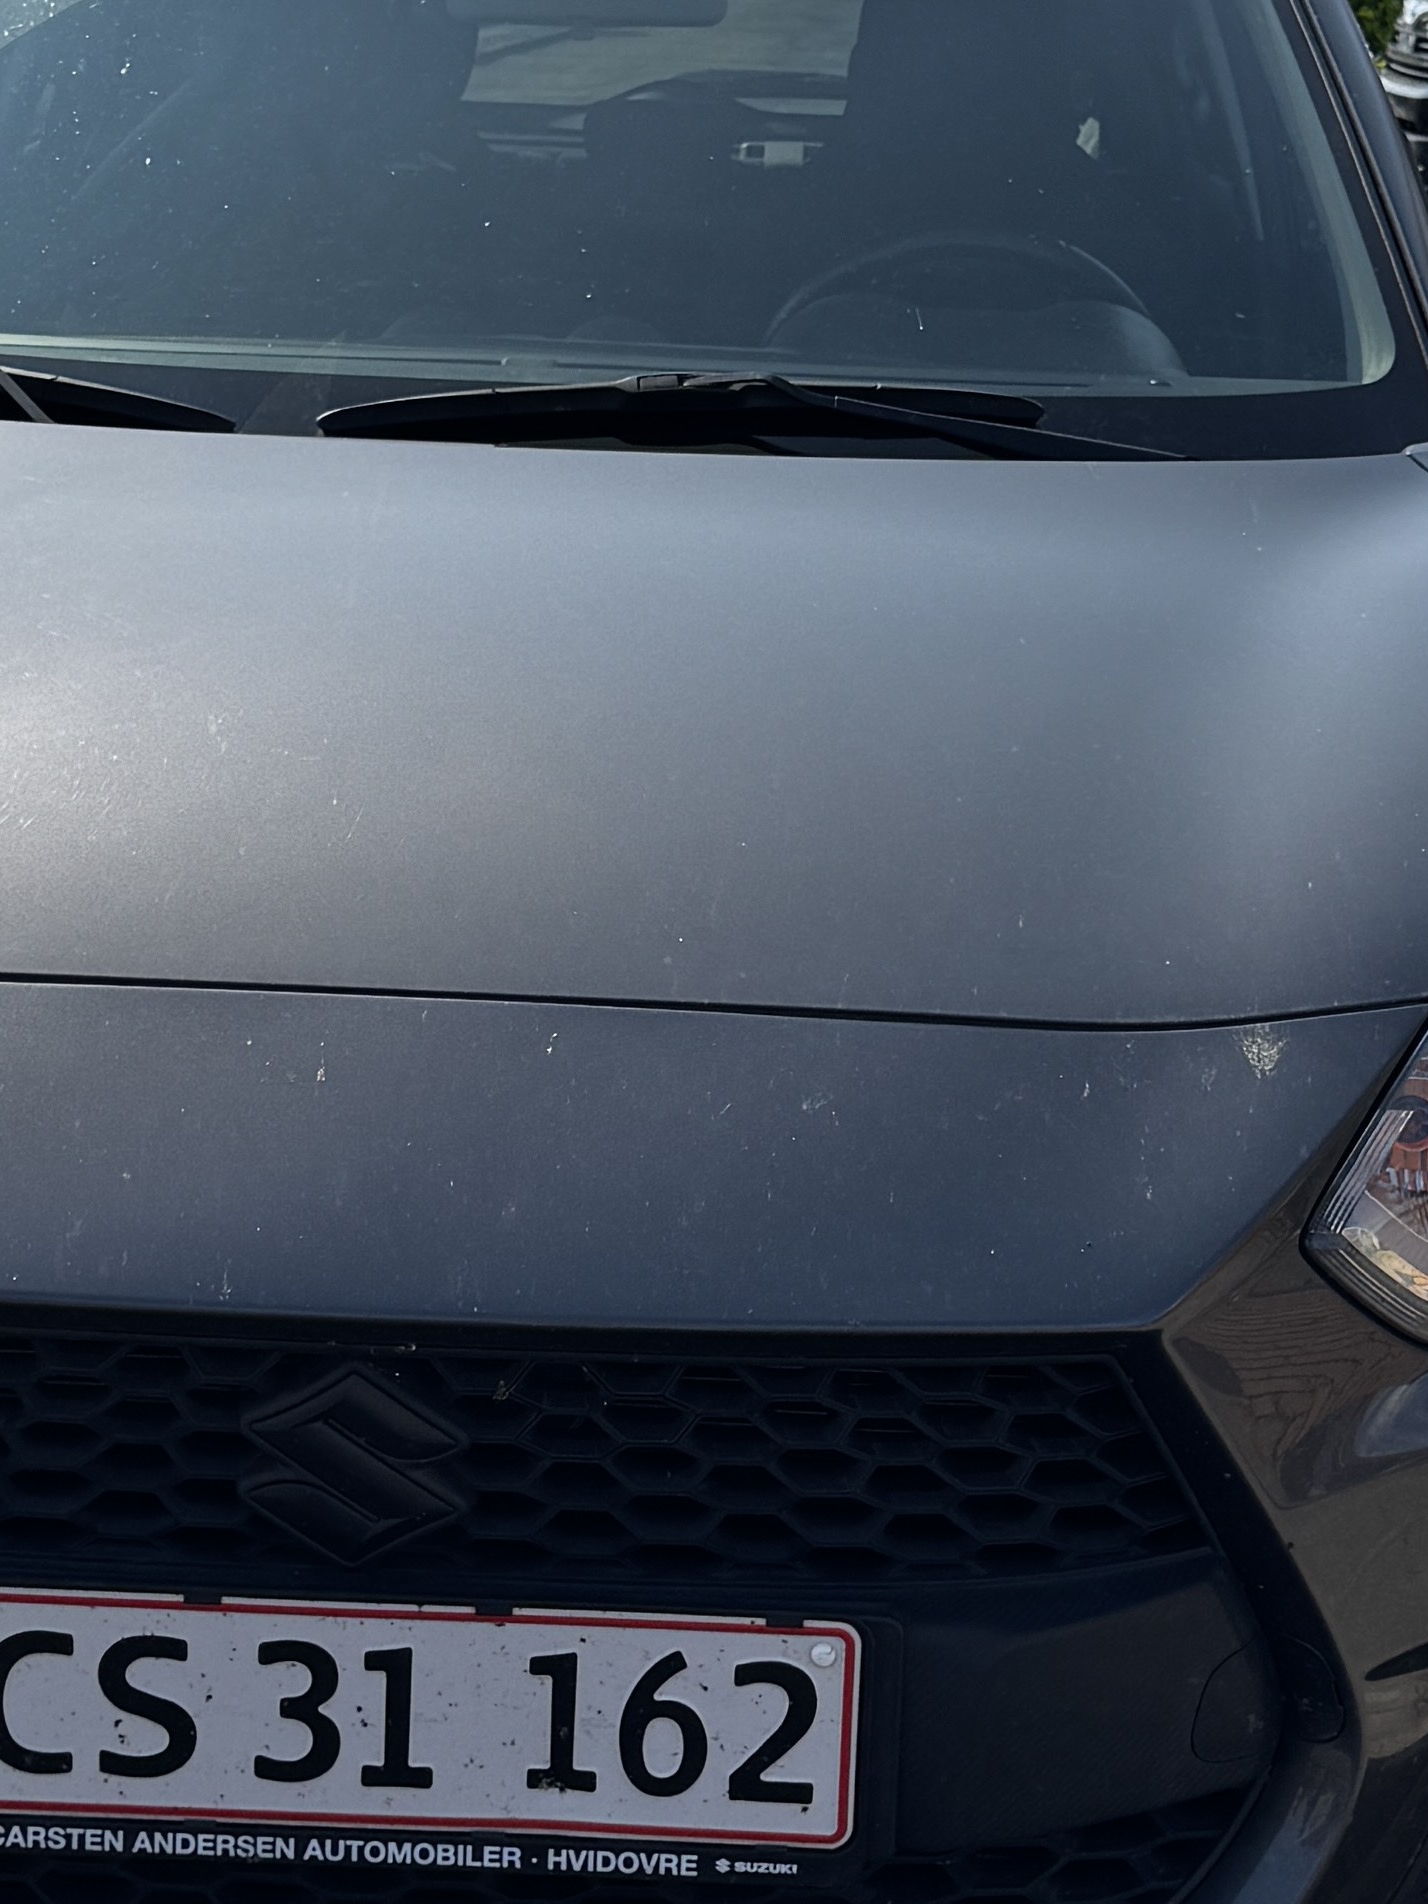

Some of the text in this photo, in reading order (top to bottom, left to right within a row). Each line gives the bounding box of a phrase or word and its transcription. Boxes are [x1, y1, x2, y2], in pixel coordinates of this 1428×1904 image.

[253, 1638, 434, 1790] 31
[525, 1649, 818, 1805] 162
[131, 1830, 295, 1861] ANDERSEN
[302, 1837, 522, 1870] AUTOMOBILER
[546, 1847, 699, 1877] HVIDOVRE
[733, 1860, 798, 1875] SUZUKI
